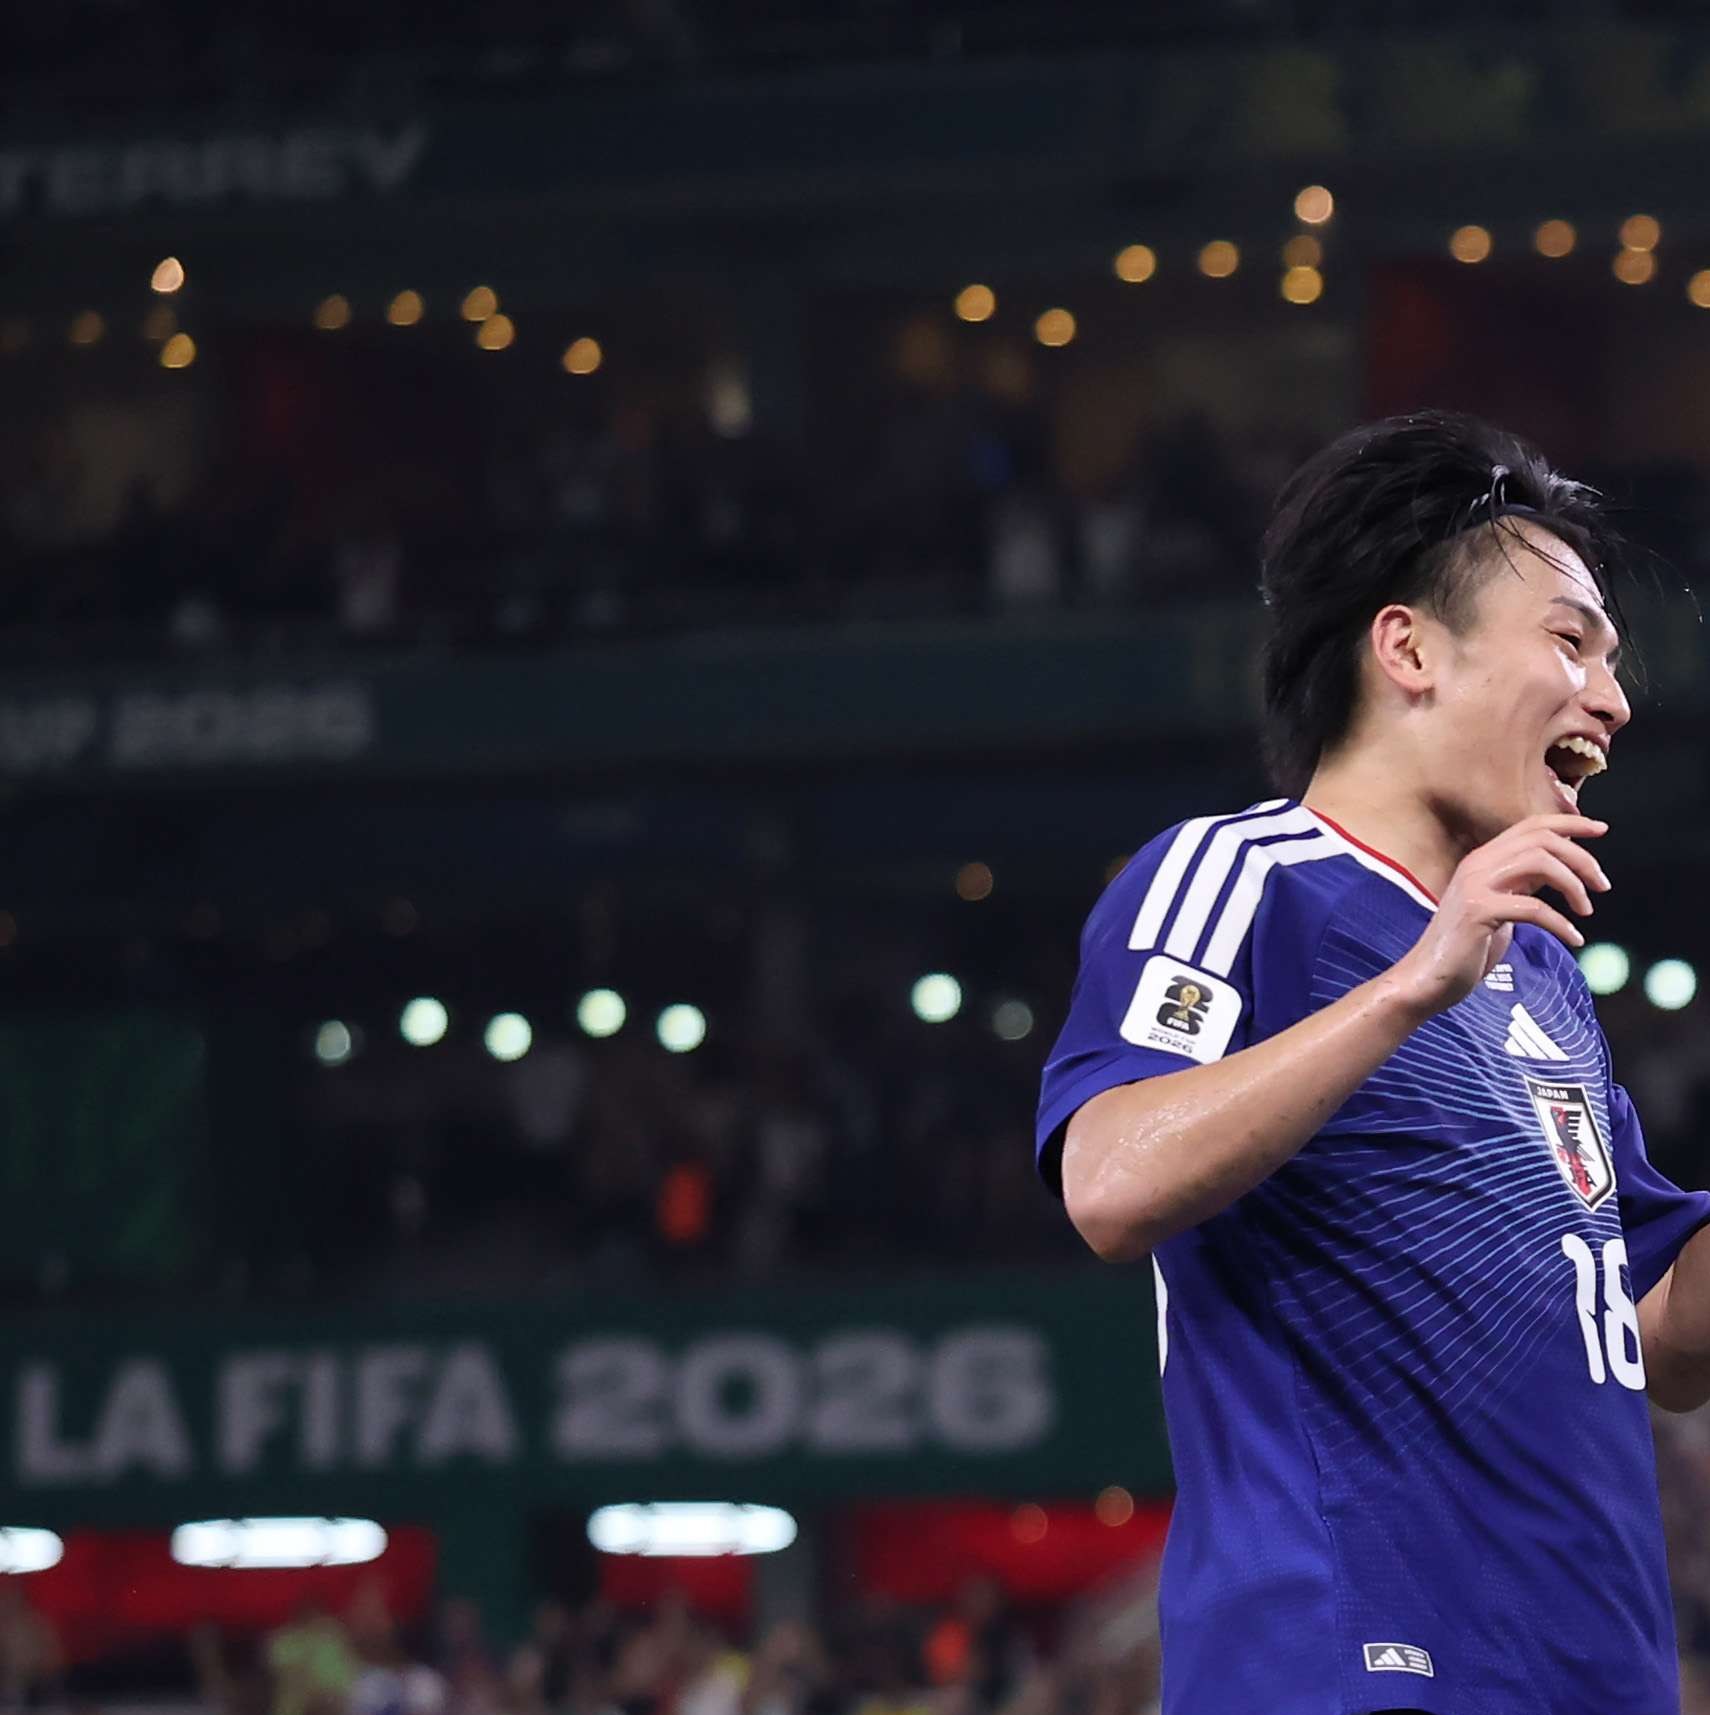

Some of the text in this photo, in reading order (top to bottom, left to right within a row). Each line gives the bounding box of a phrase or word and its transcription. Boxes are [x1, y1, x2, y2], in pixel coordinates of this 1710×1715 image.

[112, 680, 372, 758] 2026
[1147, 1032, 1194, 1054] 2026
[15, 1327, 1050, 1480] LA FIFA 2026
